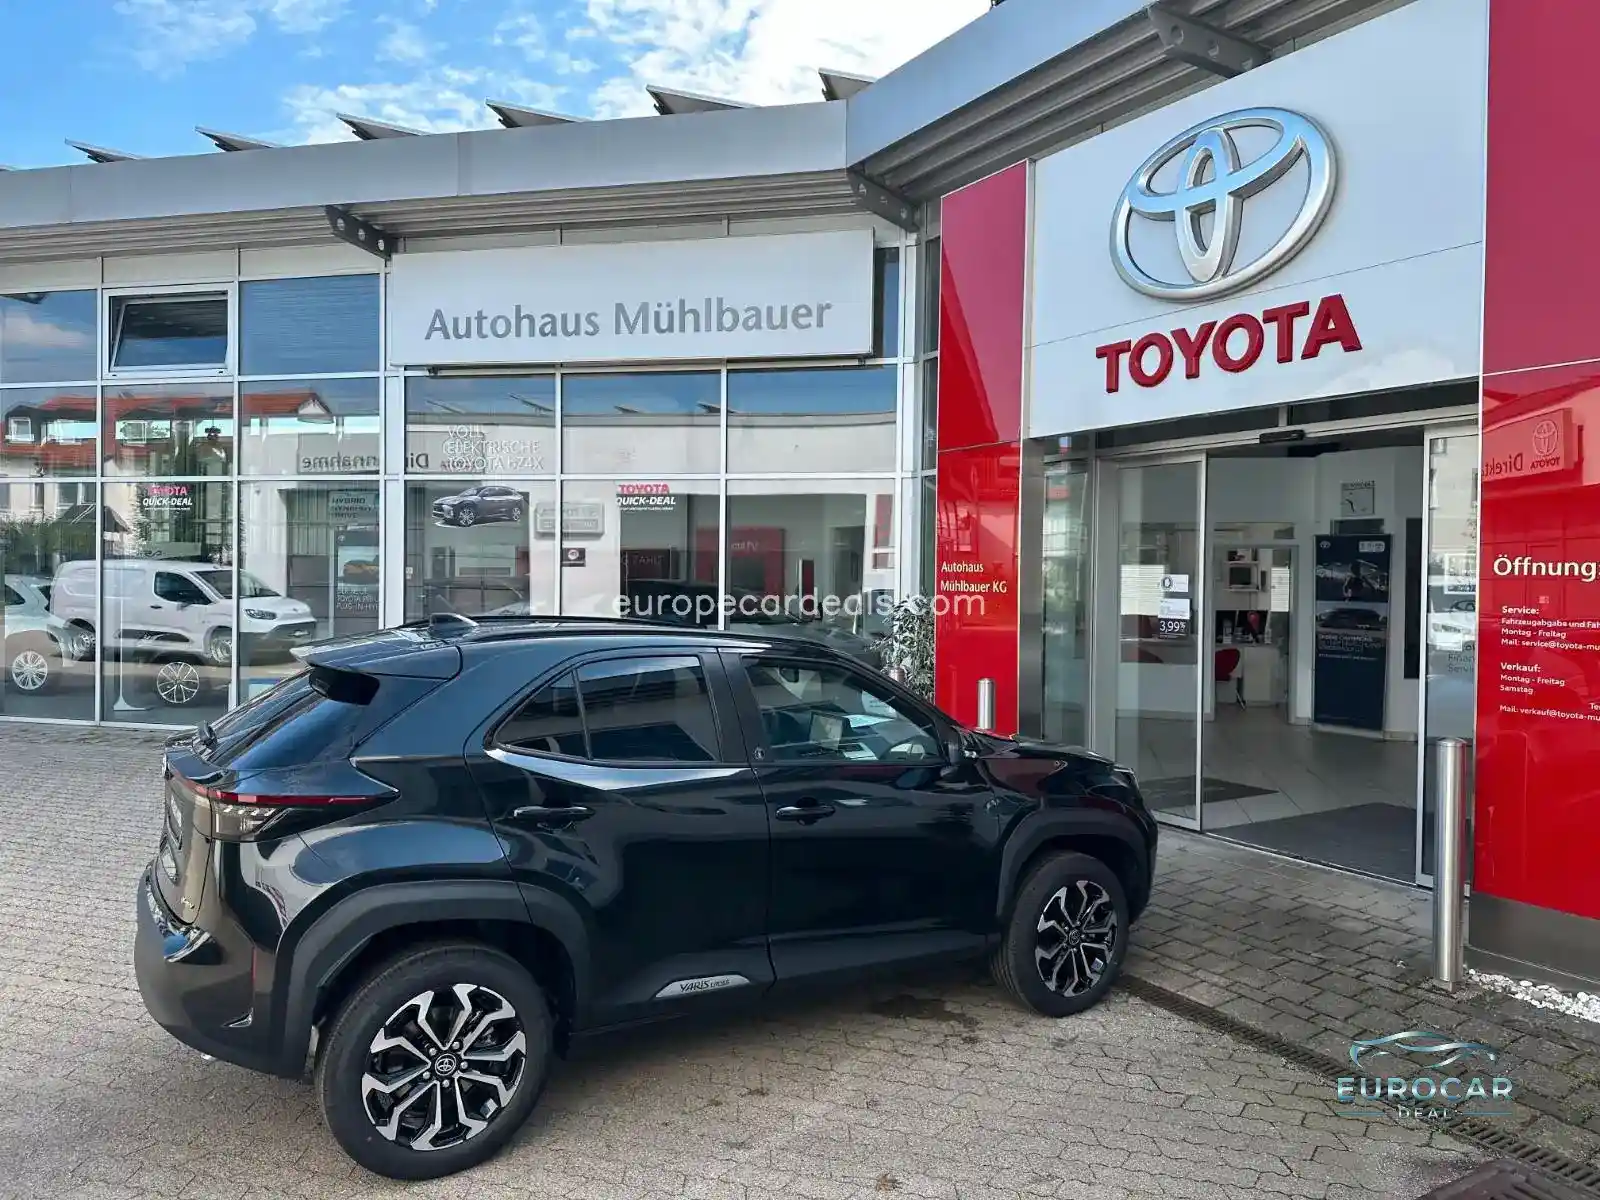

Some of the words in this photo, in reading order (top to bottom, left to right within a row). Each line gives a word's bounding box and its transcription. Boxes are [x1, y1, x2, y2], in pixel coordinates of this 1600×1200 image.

[425, 305, 600, 340] Autohaus
[614, 297, 833, 335] Mühlbauer
[1096, 294, 1362, 393] TOYOTA
[619, 483, 670, 494] TOYOTA
[142, 498, 193, 506] QUICK-DEAL
[616, 497, 676, 507] QUICK-DEAL
[941, 561, 984, 572] Autohaus
[1493, 554, 1600, 582] Öffnung
[941, 580, 990, 592] Mühlbauer
[992, 581, 1007, 593] KG
[1502, 606, 1540, 614] Service:
[1501, 628, 1531, 637] Montag
[1538, 630, 1567, 639] Freitag
[1501, 638, 1519, 646] Mail:
[1500, 662, 1541, 672] Verkauf:
[1500, 674, 1530, 683] Montag
[1537, 677, 1565, 687] Freitag
[1500, 685, 1534, 695] Samstag
[1499, 704, 1519, 713] Mail:
[680, 980, 710, 993] YARIS
